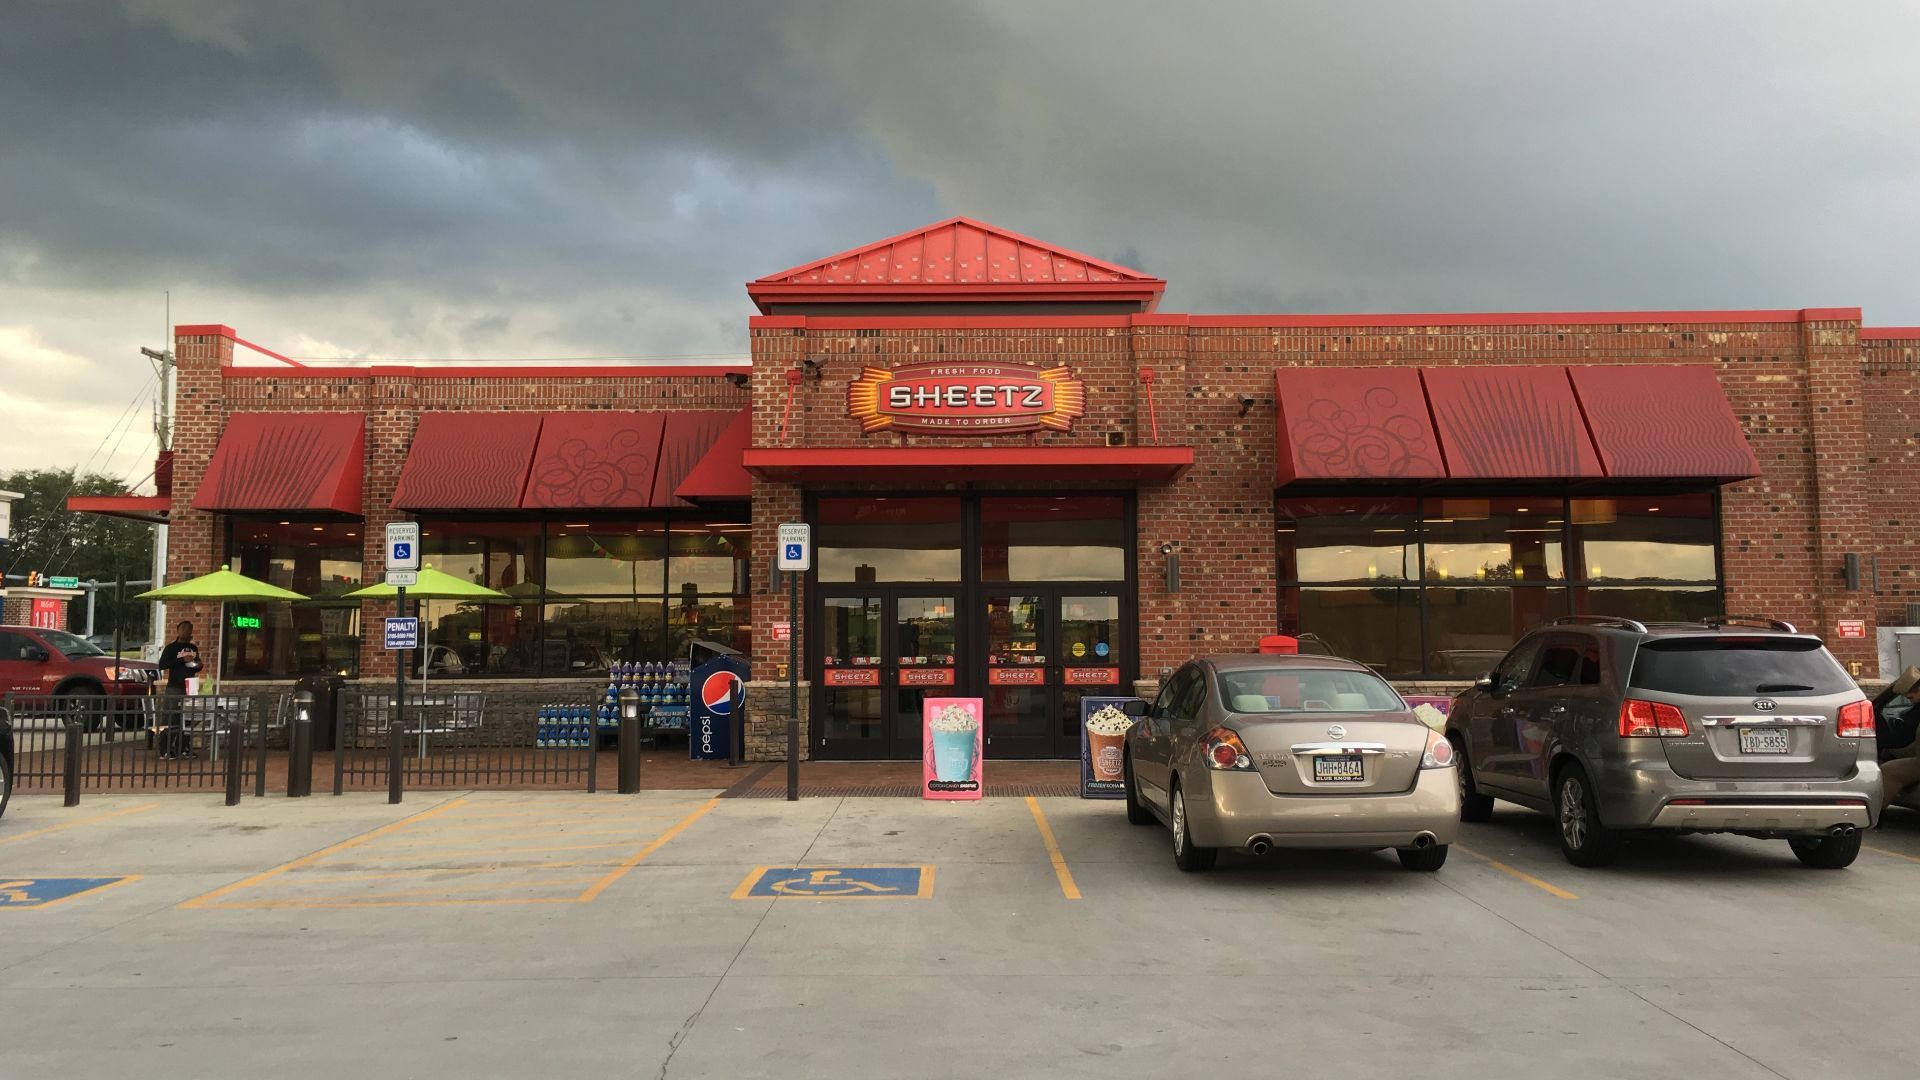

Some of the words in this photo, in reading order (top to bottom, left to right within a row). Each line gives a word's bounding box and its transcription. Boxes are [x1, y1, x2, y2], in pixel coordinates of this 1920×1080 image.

[890, 386, 1043, 407] SHEETZ
[975, 417, 1011, 425] ORDER
[387, 622, 416, 631] PENALTY
[700, 716, 713, 753] pepsi
[1744, 736, 1786, 747] YBD-5855
